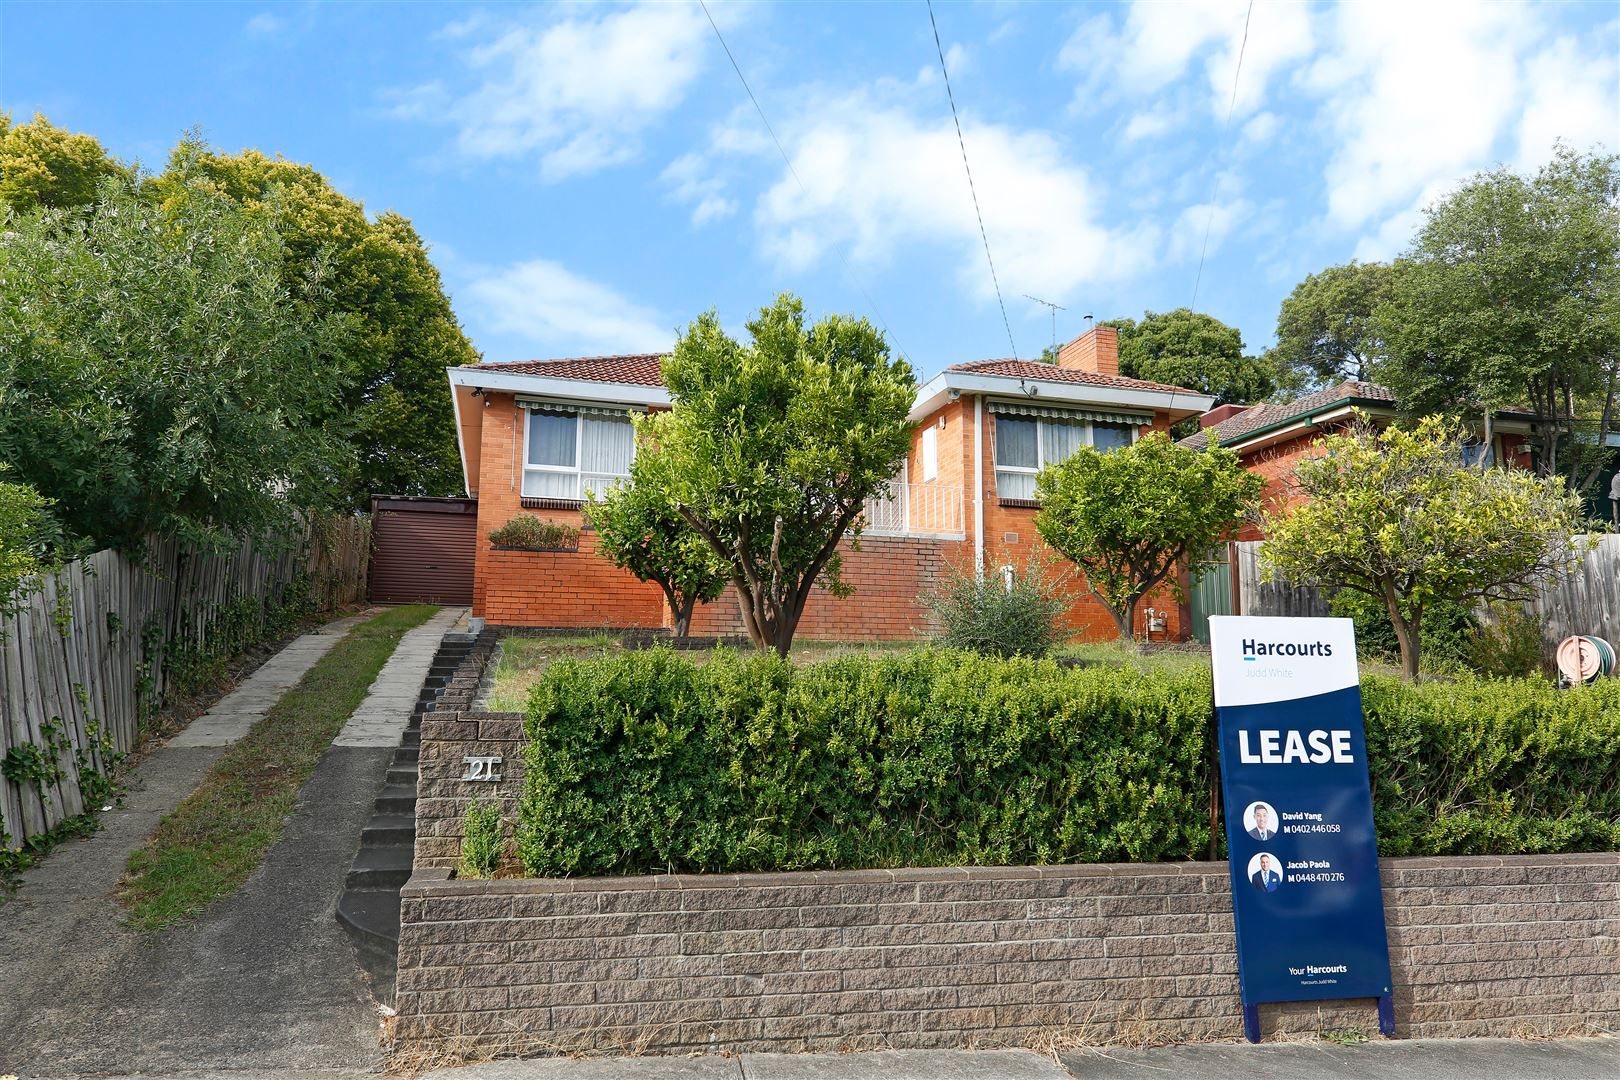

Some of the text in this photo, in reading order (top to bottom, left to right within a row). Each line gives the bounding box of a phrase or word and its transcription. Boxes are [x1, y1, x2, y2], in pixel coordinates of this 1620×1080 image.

[1242, 639, 1332, 656] Harcourts
[1246, 668, 1293, 678] Judd White
[1238, 729, 1354, 764] LEASE
[470, 757, 494, 781] 21
[1282, 812, 1322, 821] David Yang
[1286, 860, 1330, 869] Jacob Paola
[1289, 965, 1347, 975] Your Harcourts
